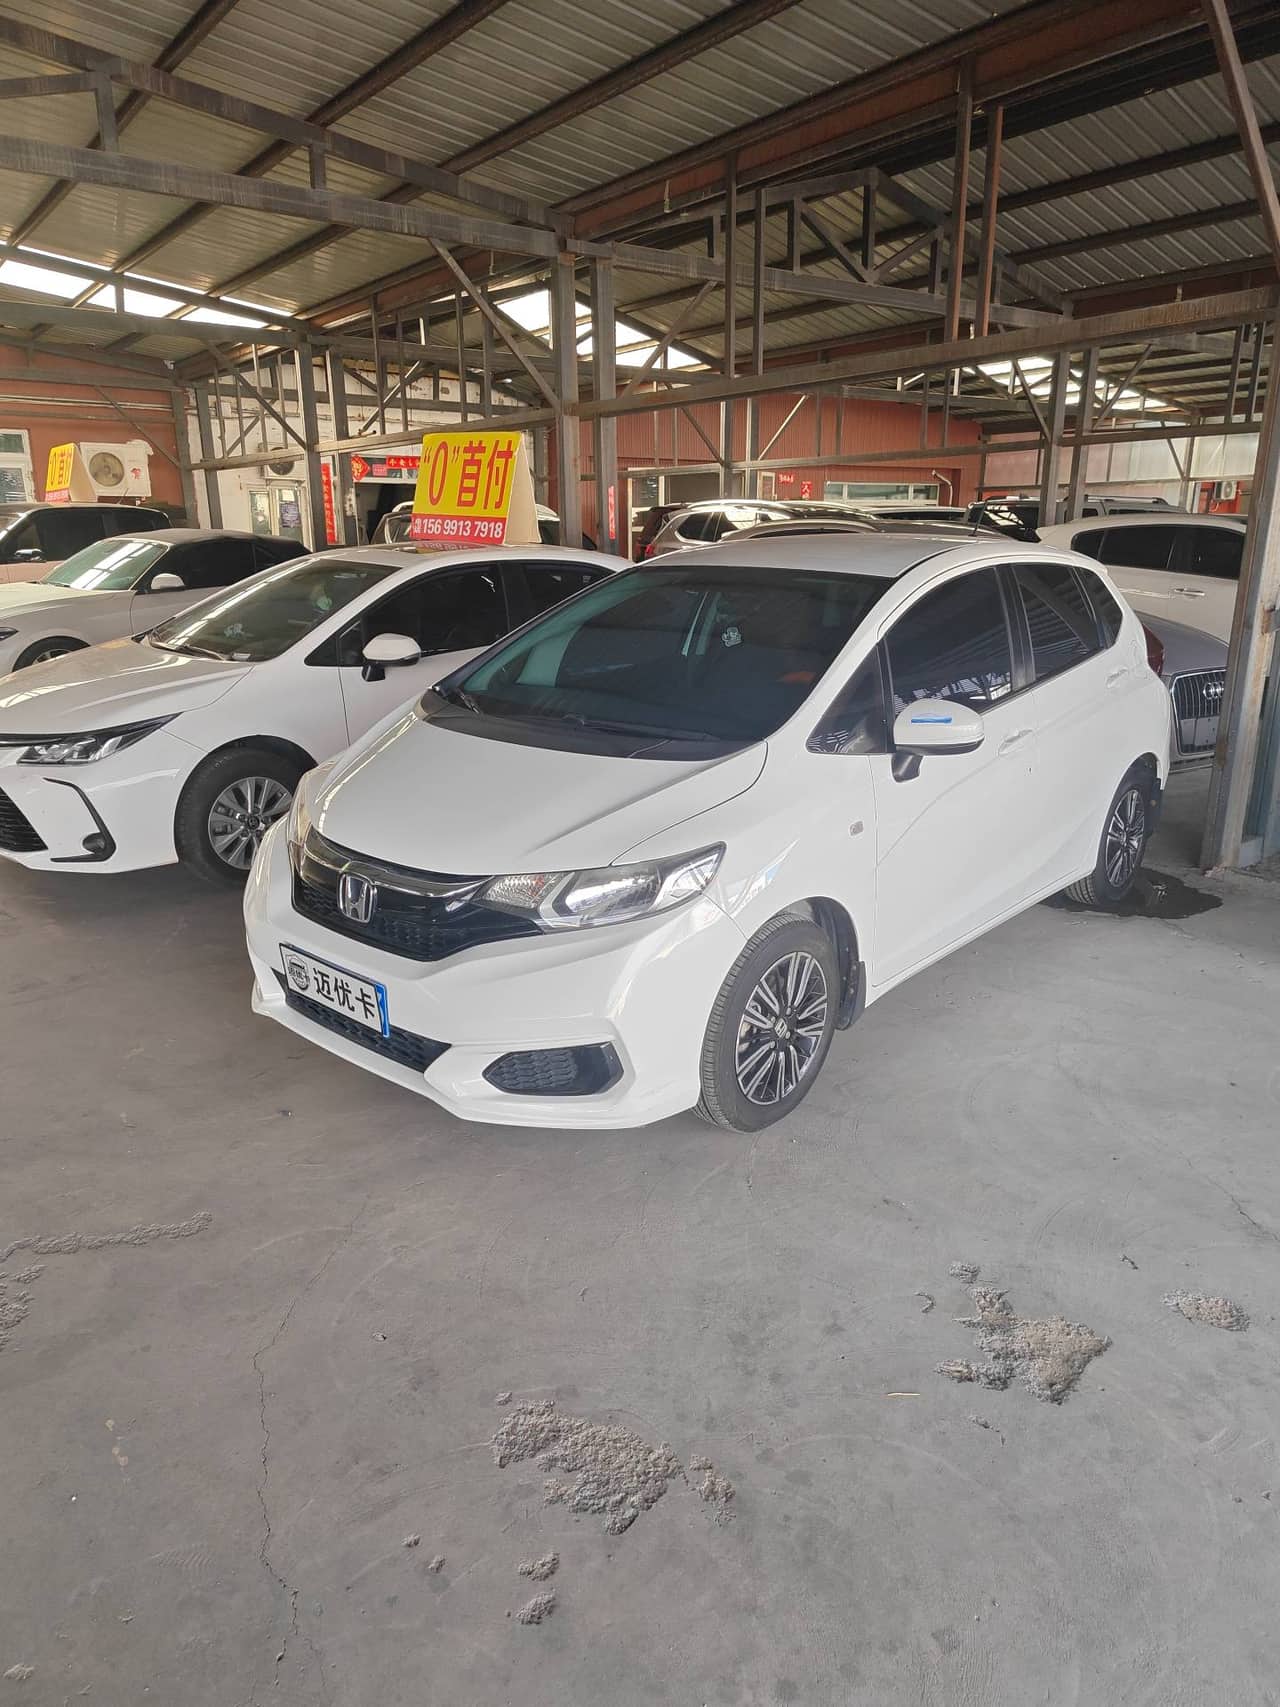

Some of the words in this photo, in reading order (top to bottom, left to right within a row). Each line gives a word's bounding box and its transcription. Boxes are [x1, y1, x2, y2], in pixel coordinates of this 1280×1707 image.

[422, 518, 442, 535] 156
[443, 519, 471, 537] 9913
[474, 520, 503, 538] 7918
[312, 966, 375, 1019] 迈优卡
